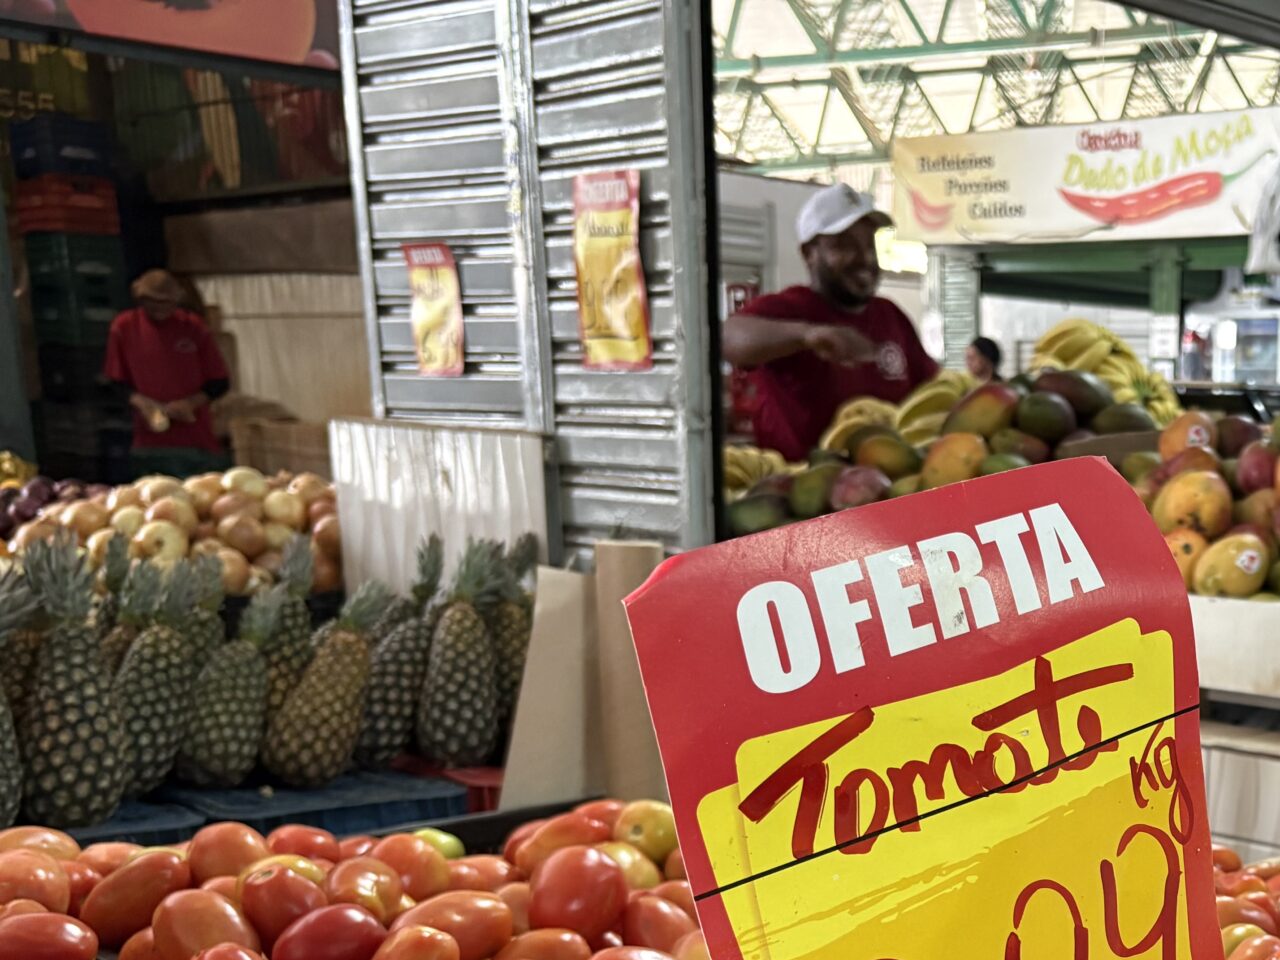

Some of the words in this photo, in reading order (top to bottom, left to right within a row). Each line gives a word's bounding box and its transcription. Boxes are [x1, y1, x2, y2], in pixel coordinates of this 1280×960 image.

[1063, 153, 1128, 190] Dedo
[1133, 150, 1164, 186] de
[736, 502, 1105, 695] OFERTA
[738, 655, 1134, 861] Tomate
